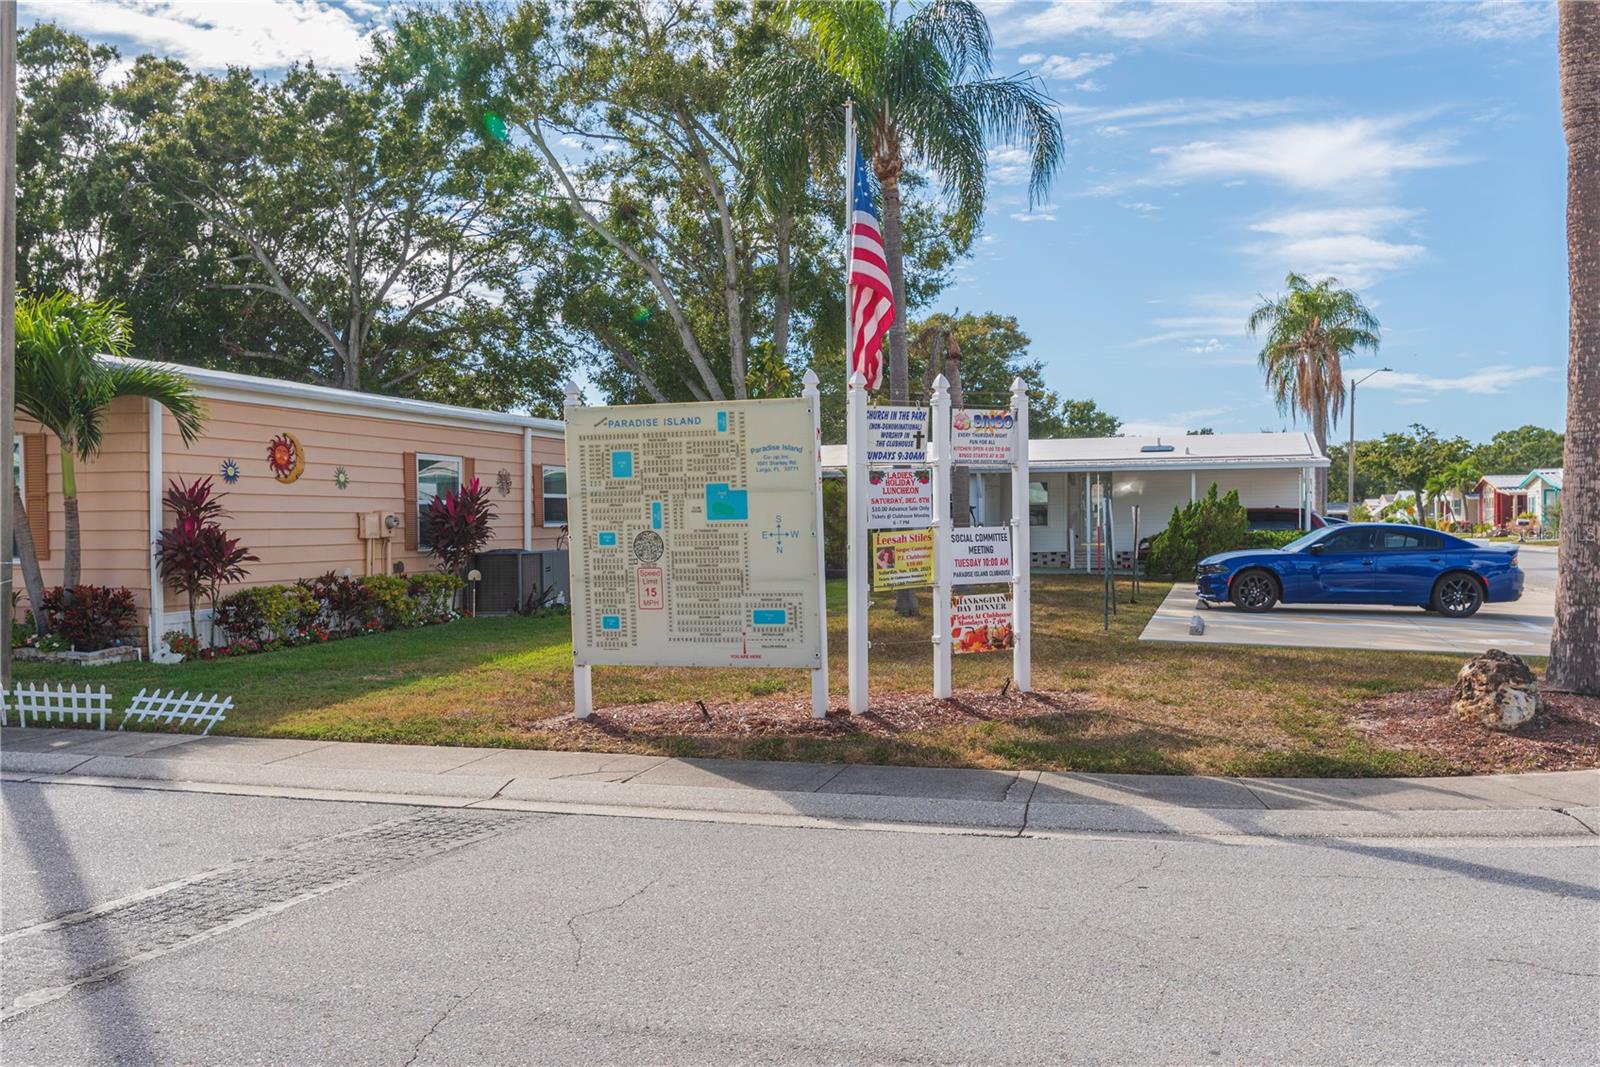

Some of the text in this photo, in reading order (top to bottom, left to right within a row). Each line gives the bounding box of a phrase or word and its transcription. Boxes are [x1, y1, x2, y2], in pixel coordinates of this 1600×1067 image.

[891, 411, 897, 420] IN
[899, 411, 910, 420] THE
[911, 411, 927, 421] PARK
[608, 416, 701, 428] PARADISE ISLAND
[973, 414, 1014, 430] BINGO
[876, 440, 914, 448] THE CLUBHOUSE
[750, 443, 803, 455] Paradise Island
[866, 452, 896, 460] UNDAYS
[886, 478, 916, 486] HOLIDAY
[882, 486, 920, 495] LUNCHEON
[776, 514, 782, 523] S
[762, 530, 800, 540] E W
[877, 533, 932, 546] Leesah Stiles
[950, 532, 1008, 543] SOCIAL COMMITTEE
[776, 546, 784, 554] N
[968, 545, 994, 554] MEETING
[954, 557, 1009, 568] TUESDAY 10:00 AM
[644, 588, 656, 597] 15
[955, 594, 1010, 605] HANKSGIVING
[975, 603, 1007, 611] DINNER
